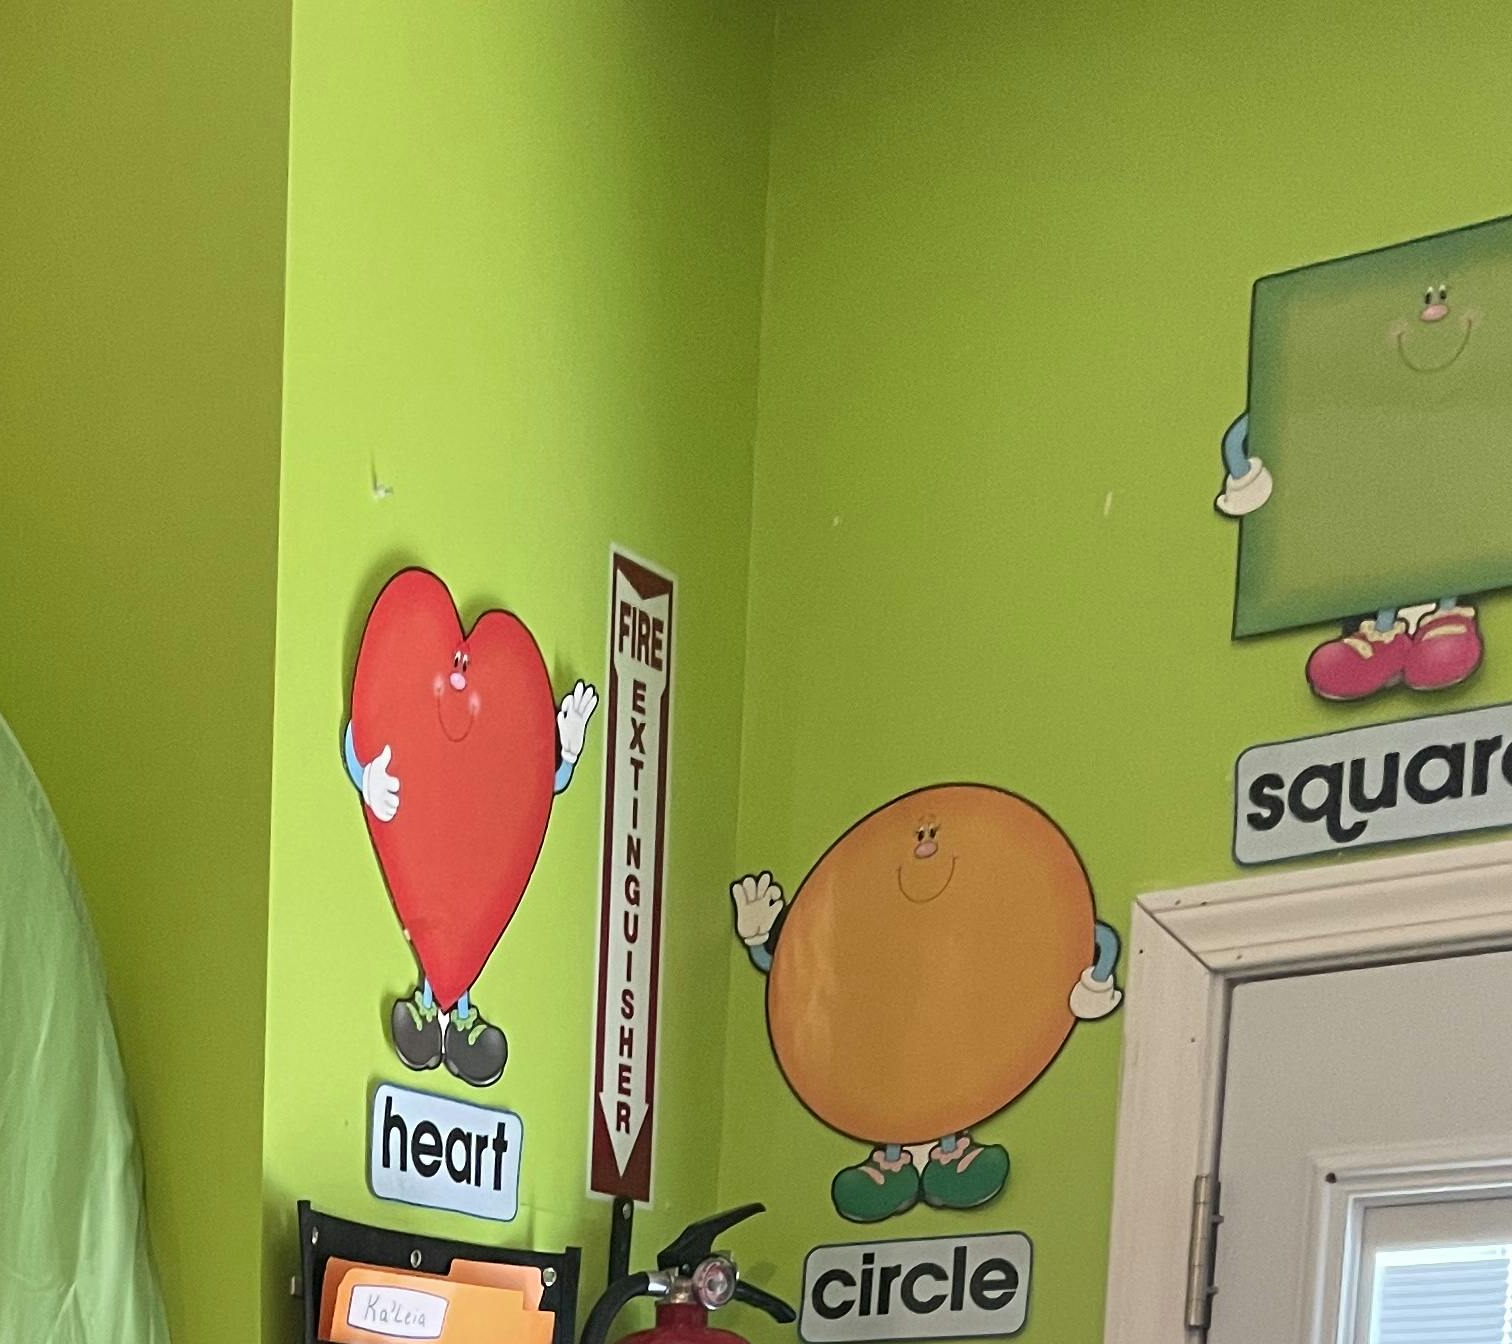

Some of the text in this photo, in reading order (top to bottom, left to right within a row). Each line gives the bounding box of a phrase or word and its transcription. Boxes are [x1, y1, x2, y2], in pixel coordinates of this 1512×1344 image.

[618, 605, 664, 671] FIRE
[1246, 733, 1512, 843] squar
[615, 680, 648, 1135] EXTINGUISHER
[381, 1095, 509, 1192] heart
[810, 1244, 1020, 1321] circle
